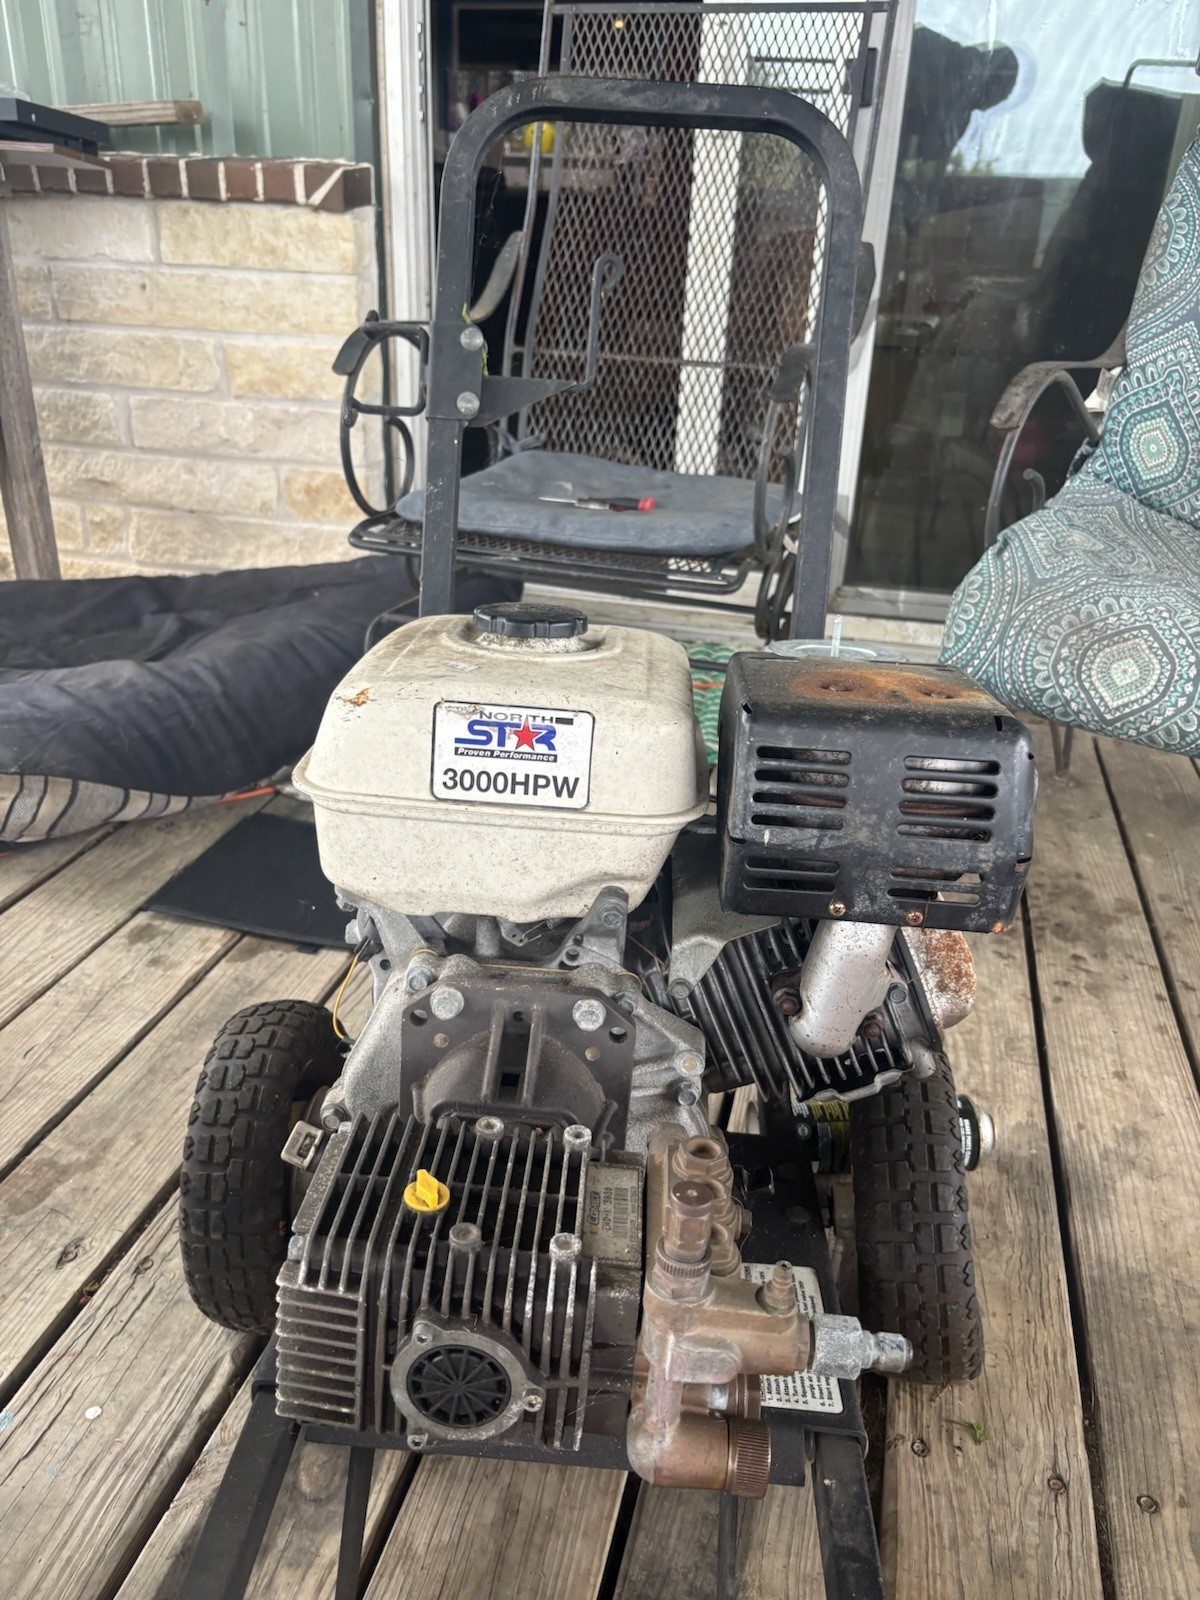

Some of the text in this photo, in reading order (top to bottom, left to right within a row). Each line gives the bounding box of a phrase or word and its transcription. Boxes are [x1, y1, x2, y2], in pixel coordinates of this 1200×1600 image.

[480, 710, 553, 724] NORTH
[454, 717, 556, 751] STAR
[458, 748, 555, 762] Proven Performance
[442, 768, 580, 798] 3000HPW
